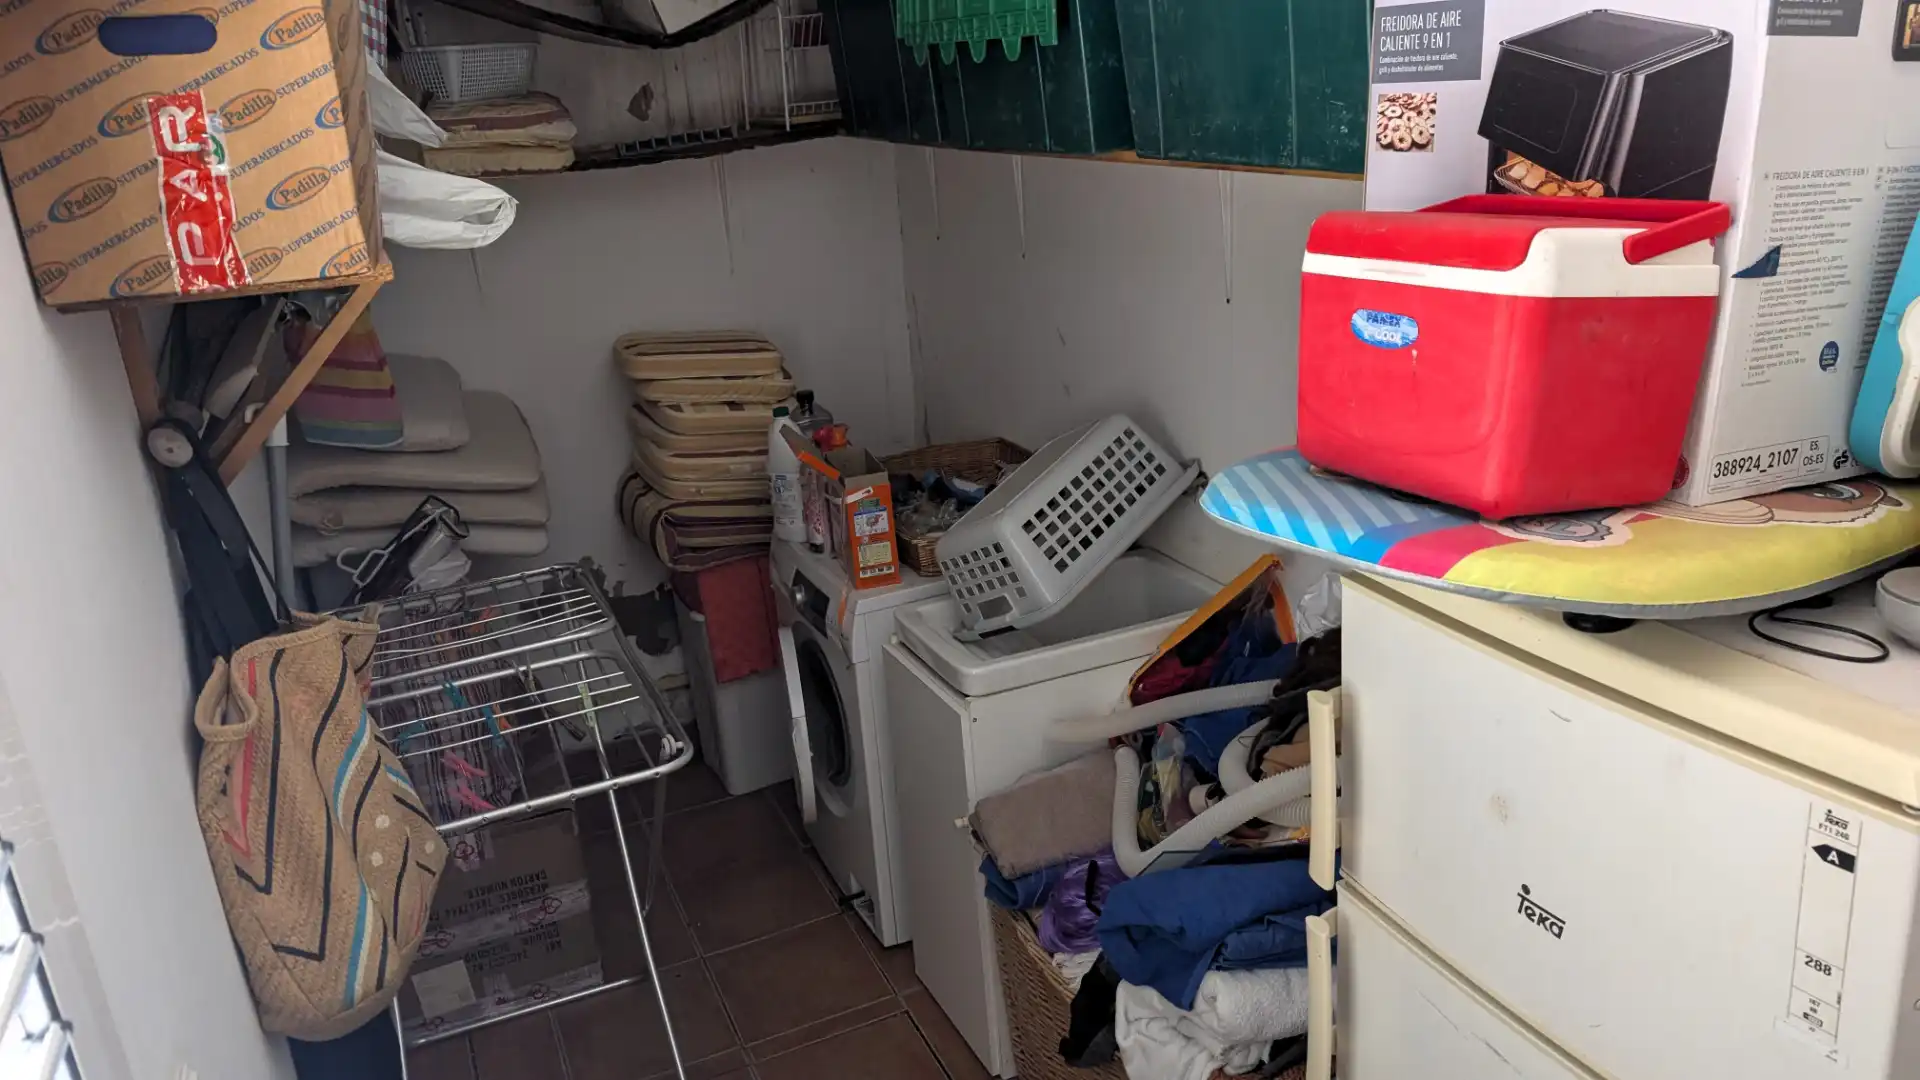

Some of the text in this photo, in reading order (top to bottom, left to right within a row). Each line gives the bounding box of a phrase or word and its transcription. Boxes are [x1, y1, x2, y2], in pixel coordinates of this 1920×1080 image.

[51, 13, 103, 48] Padilla
[274, 11, 324, 43] Padilla
[1380, 9, 1462, 32] FREIDORA DE AIRE
[1380, 31, 1451, 52] CALIENTE 9 EN 1
[0, 102, 51, 136] Padilla
[114, 102, 147, 129] Padi
[222, 94, 274, 126] Padilla
[10, 136, 98, 190] UPERMERCADOS
[63, 184, 114, 216] Padilla
[157, 105, 222, 292] PAR
[280, 171, 329, 203] Padilla
[68, 215, 159, 270] SUPERMERCADOS
[246, 252, 281, 277] dilla
[333, 247, 369, 275] Padill
[36, 266, 65, 288] illa
[1802, 453, 1824, 466] OS-ES
[1809, 440, 1820, 451] ES,
[1833, 450, 1849, 470] GS
[1713, 448, 1799, 479] 388924_2107
[1826, 850, 1840, 865] A
[1516, 884, 1566, 940] Teka
[1804, 954, 1833, 977] 288
